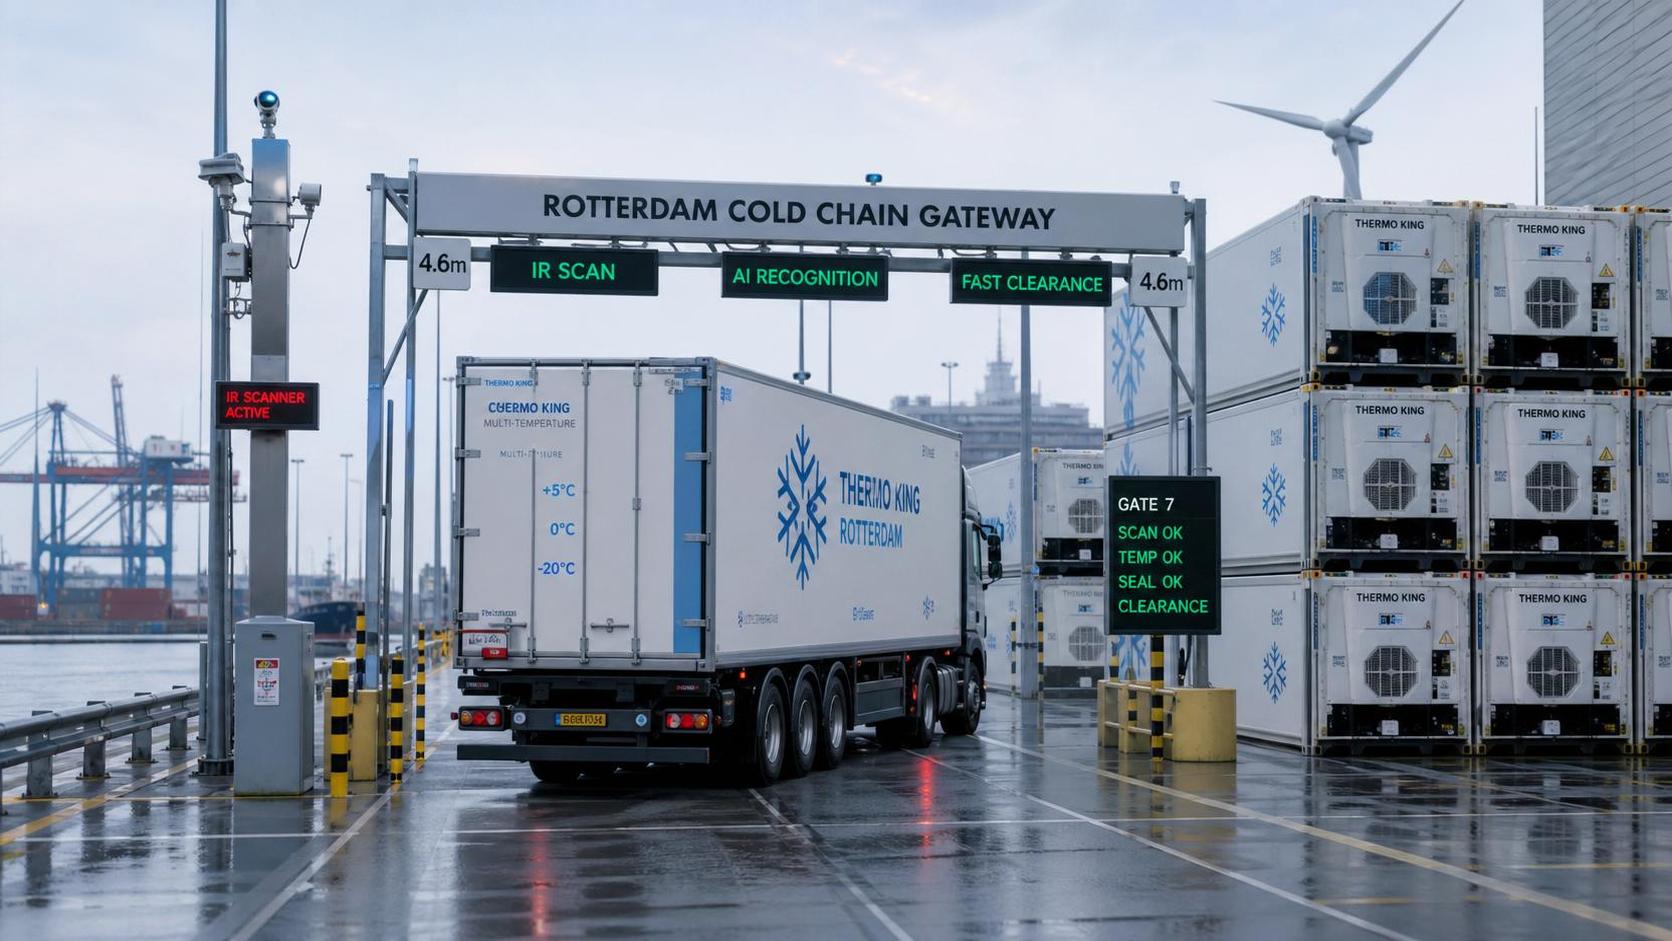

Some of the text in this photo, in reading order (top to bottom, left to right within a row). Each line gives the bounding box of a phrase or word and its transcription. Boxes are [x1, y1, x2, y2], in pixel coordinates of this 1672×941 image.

[543, 194, 1056, 230] ROTTERDAM COLD CHAIN GATEWAY
[1355, 219, 1424, 231] THERMO KING
[1517, 224, 1586, 235] THERMO KING
[418, 253, 467, 275] 4.6m
[531, 261, 616, 281] IR SCAN
[732, 268, 879, 288] AI RECOGNITION
[961, 273, 1103, 293] FAST CLEARANCE
[1139, 272, 1184, 292] 4.6m
[485, 379, 513, 387] THERMO
[226, 391, 305, 404] IR SCANNER
[226, 407, 270, 419] ACTIVE
[541, 402, 570, 413] KING
[1356, 405, 1425, 415] THERMO KING
[1518, 408, 1586, 419] THERMO KING
[840, 471, 920, 515] THERMO KING
[1118, 497, 1175, 511] GATE 7
[550, 523, 575, 536] 0°C
[840, 517, 903, 549] ROTTERDAM
[1118, 526, 1183, 540] SCAN OK
[1119, 551, 1183, 564] TEMP OK
[1118, 575, 1183, 589] SEAL OK
[1357, 592, 1426, 603] THERMO KING
[1519, 594, 1587, 604] THERMO KING
[1118, 600, 1208, 614] CLEARANCE
